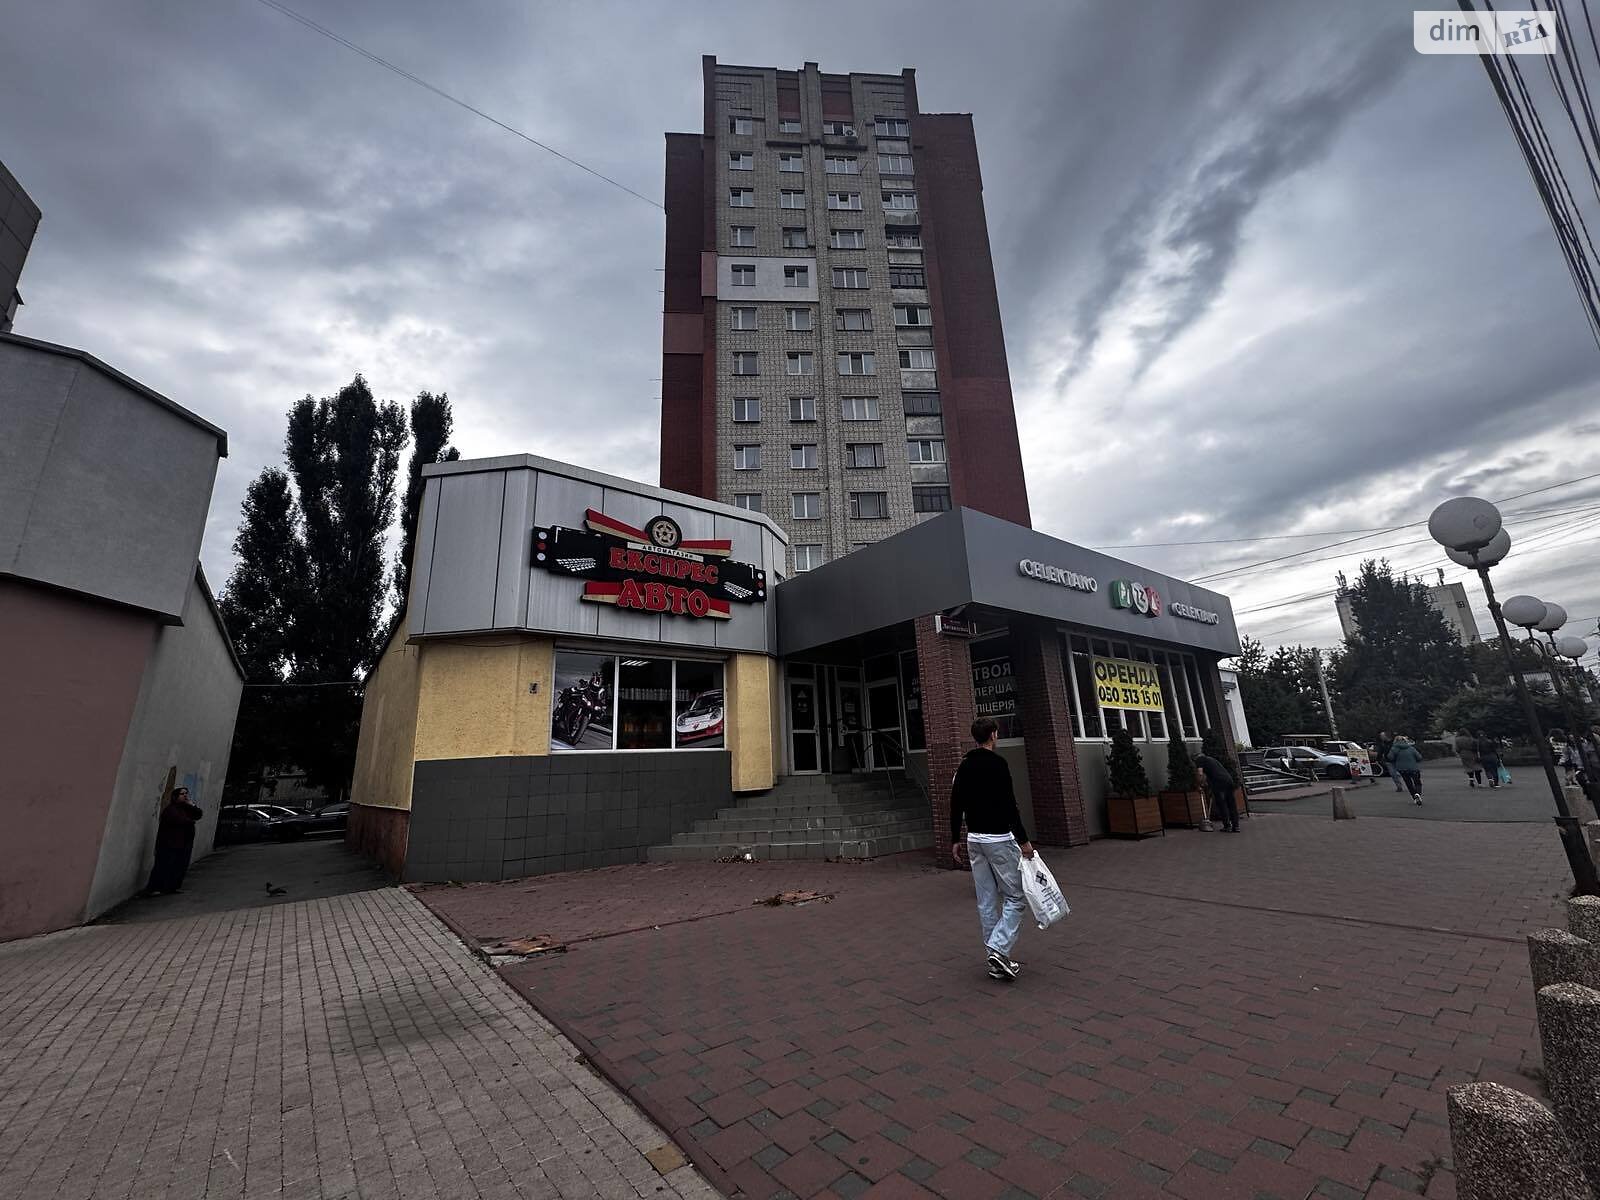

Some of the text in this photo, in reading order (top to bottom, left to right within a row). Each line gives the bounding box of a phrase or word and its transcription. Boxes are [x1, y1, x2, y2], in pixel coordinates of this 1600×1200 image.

[642, 545, 693, 559] АВТОМАГАЗИН
[609, 547, 719, 584] ЕКСПРЕС
[1019, 559, 1098, 593] CELENTANO
[617, 578, 711, 617] АВТО
[1172, 602, 1219, 625] CELENTANO
[974, 662, 1012, 681] ТВОЯ
[1094, 662, 1160, 688] ОРЕНДА
[975, 682, 1013, 697] ПЕРША
[1099, 685, 1119, 702] 050
[1122, 688, 1140, 705] 313
[1141, 690, 1151, 706] 15
[976, 699, 1015, 713] ПІЦЕРІЯ
